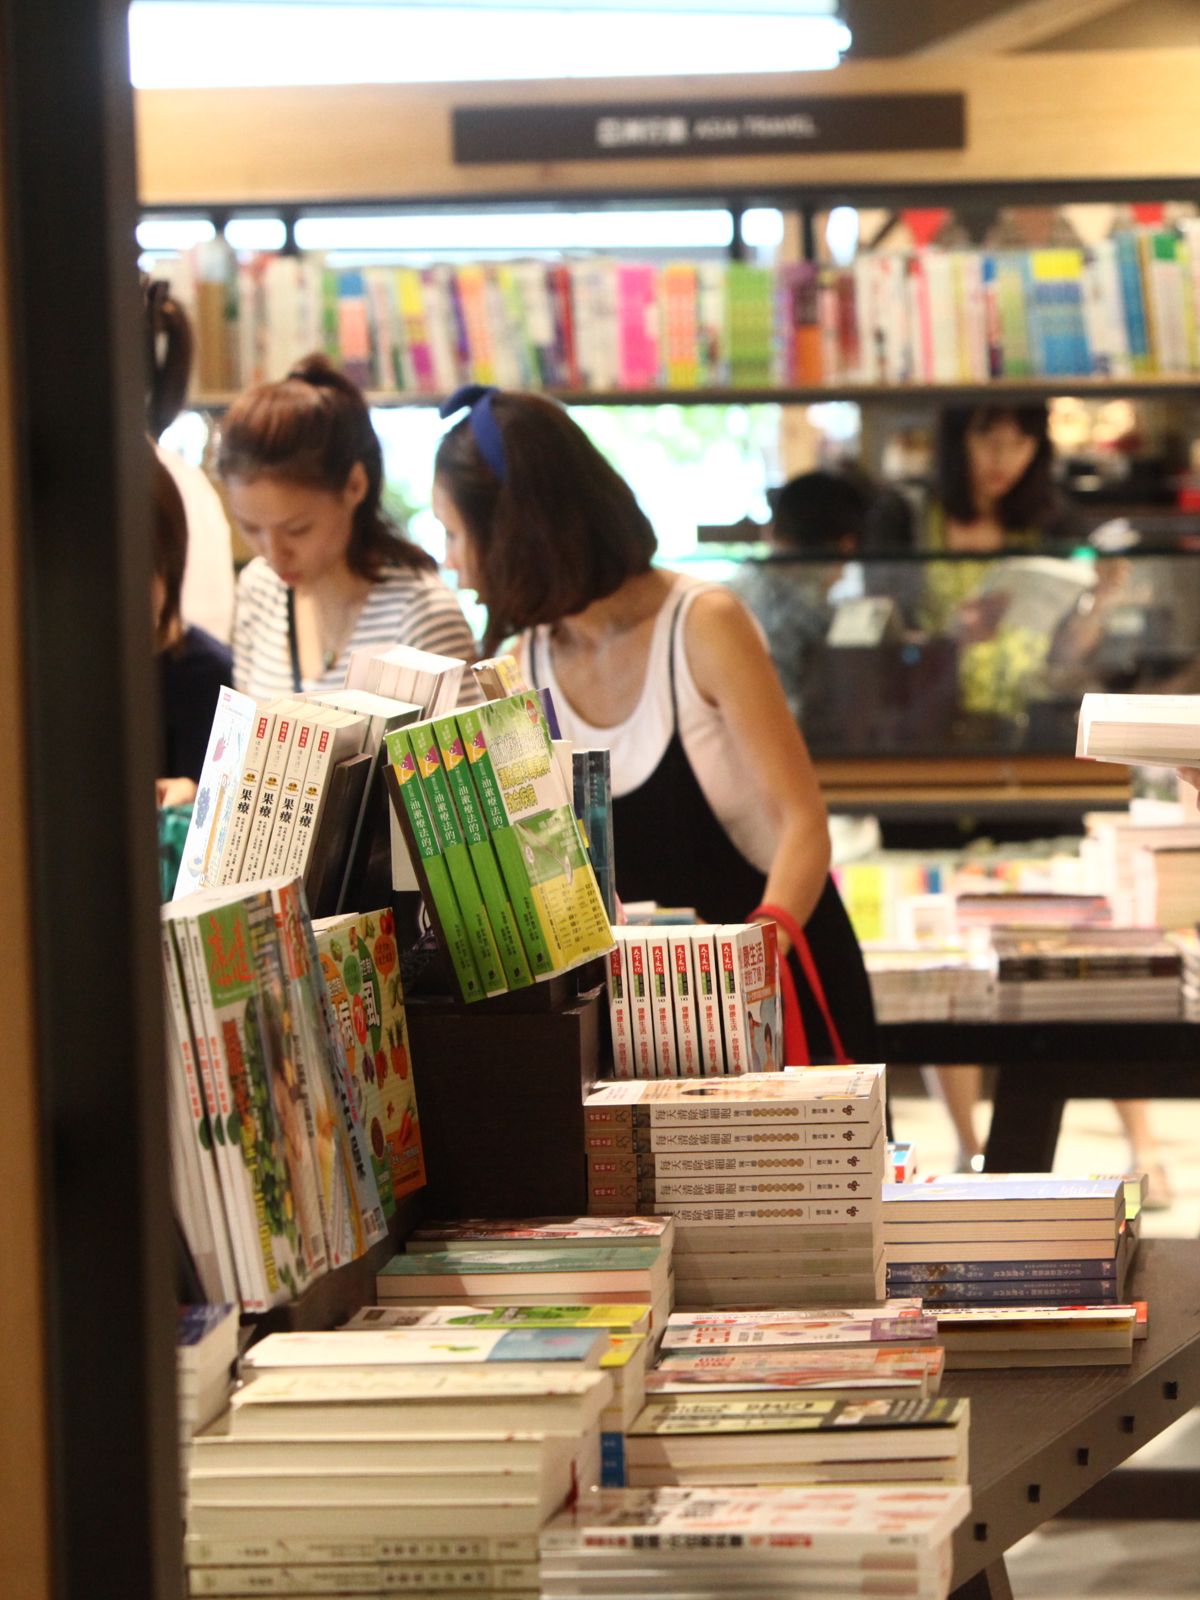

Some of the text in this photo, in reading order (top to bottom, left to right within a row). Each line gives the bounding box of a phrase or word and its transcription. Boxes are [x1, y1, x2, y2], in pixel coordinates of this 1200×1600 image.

[238, 788, 252, 815] 果療
[259, 792, 274, 819] 果療
[280, 797, 294, 824] 果療
[481, 778, 503, 829] 油漱療法的
[299, 802, 314, 829] 果療
[656, 1108, 732, 1121] 每天清除癌細胞
[656, 1132, 732, 1146] 每天清除癌細胞
[660, 1158, 736, 1172] 每天清除癌細胞
[660, 1183, 736, 1196] 每天清除癌細胞
[672, 1208, 736, 1222] 天清除癌細胞
